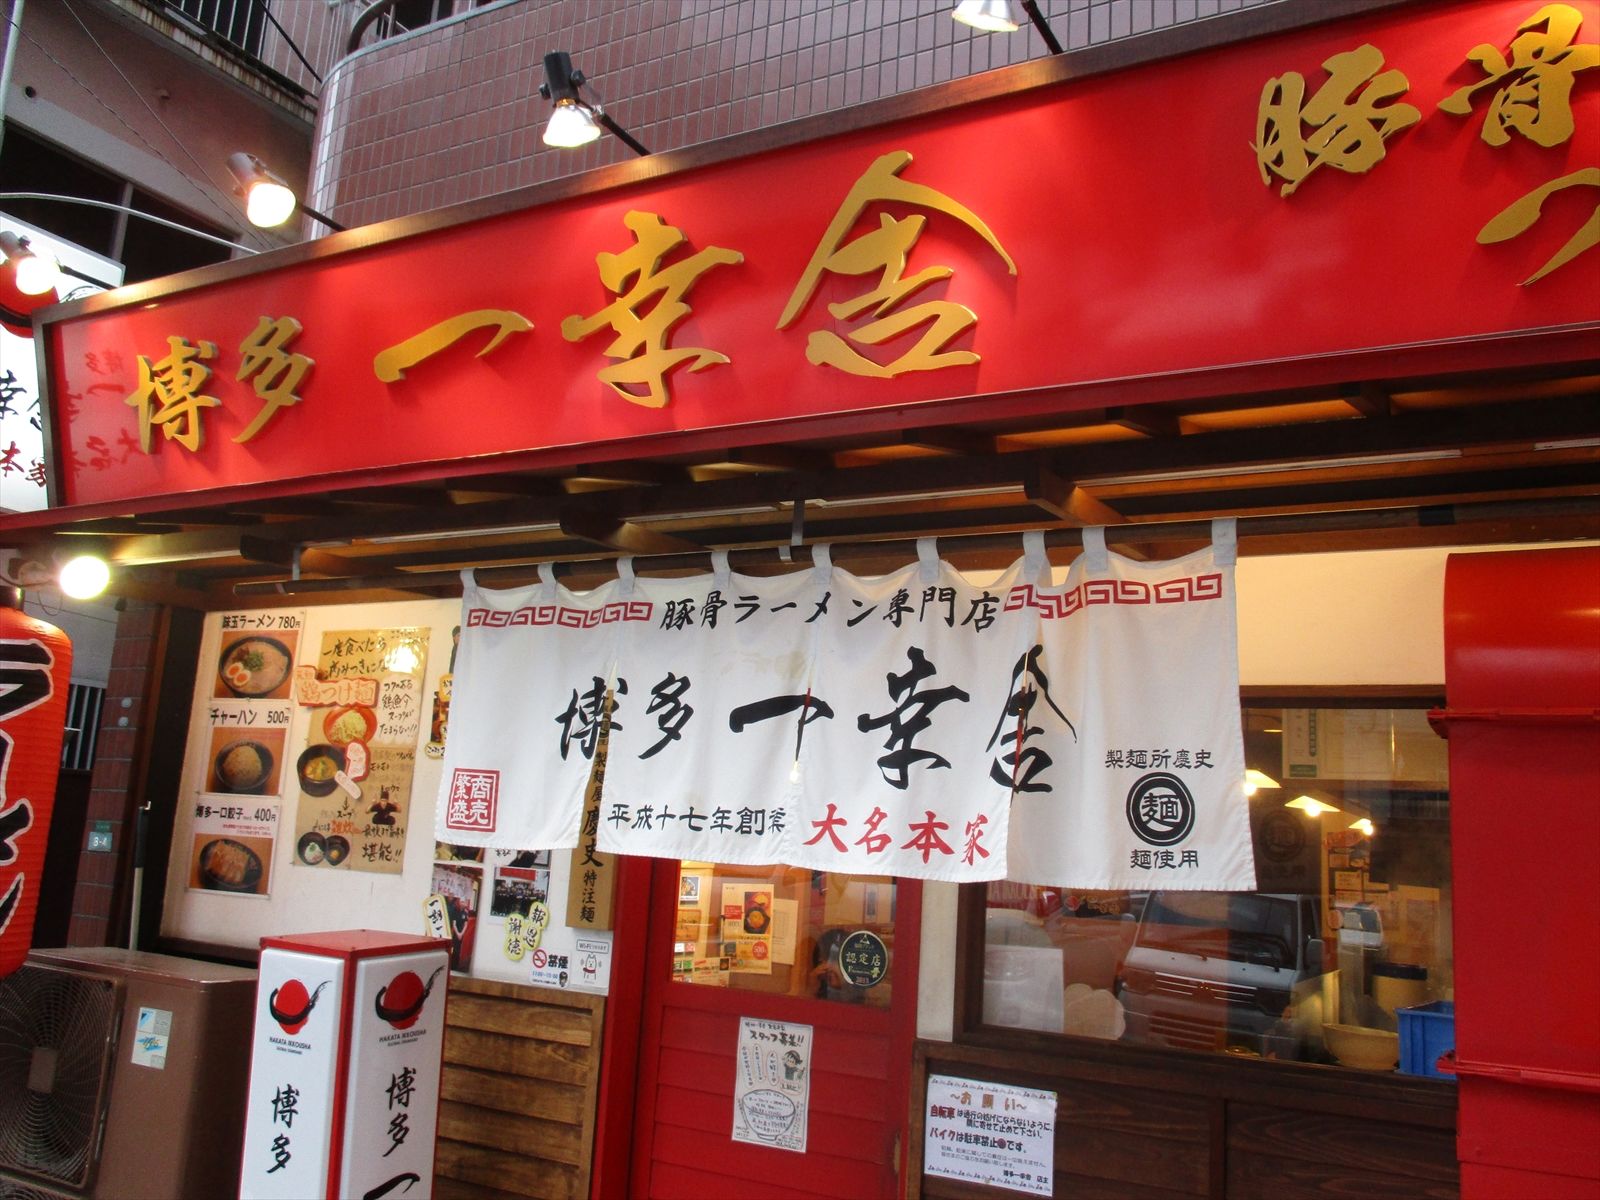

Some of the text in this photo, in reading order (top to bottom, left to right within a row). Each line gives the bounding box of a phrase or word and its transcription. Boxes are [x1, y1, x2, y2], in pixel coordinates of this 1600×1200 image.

[660, 586, 999, 632] 豚骨ラーメン専門店
[222, 614, 300, 629] 味玉ラーメン 780円
[210, 708, 289, 725] チャーハン 500円
[1105, 749, 1214, 769] 製麺所慶史
[254, 807, 276, 822] 400円
[607, 804, 786, 836] 平成十七年創業
[803, 803, 989, 864] 大名本家
[1130, 849, 1198, 869] 麺使用
[548, 954, 568, 969] 禁煙
[267, 1084, 299, 1174] 博多
